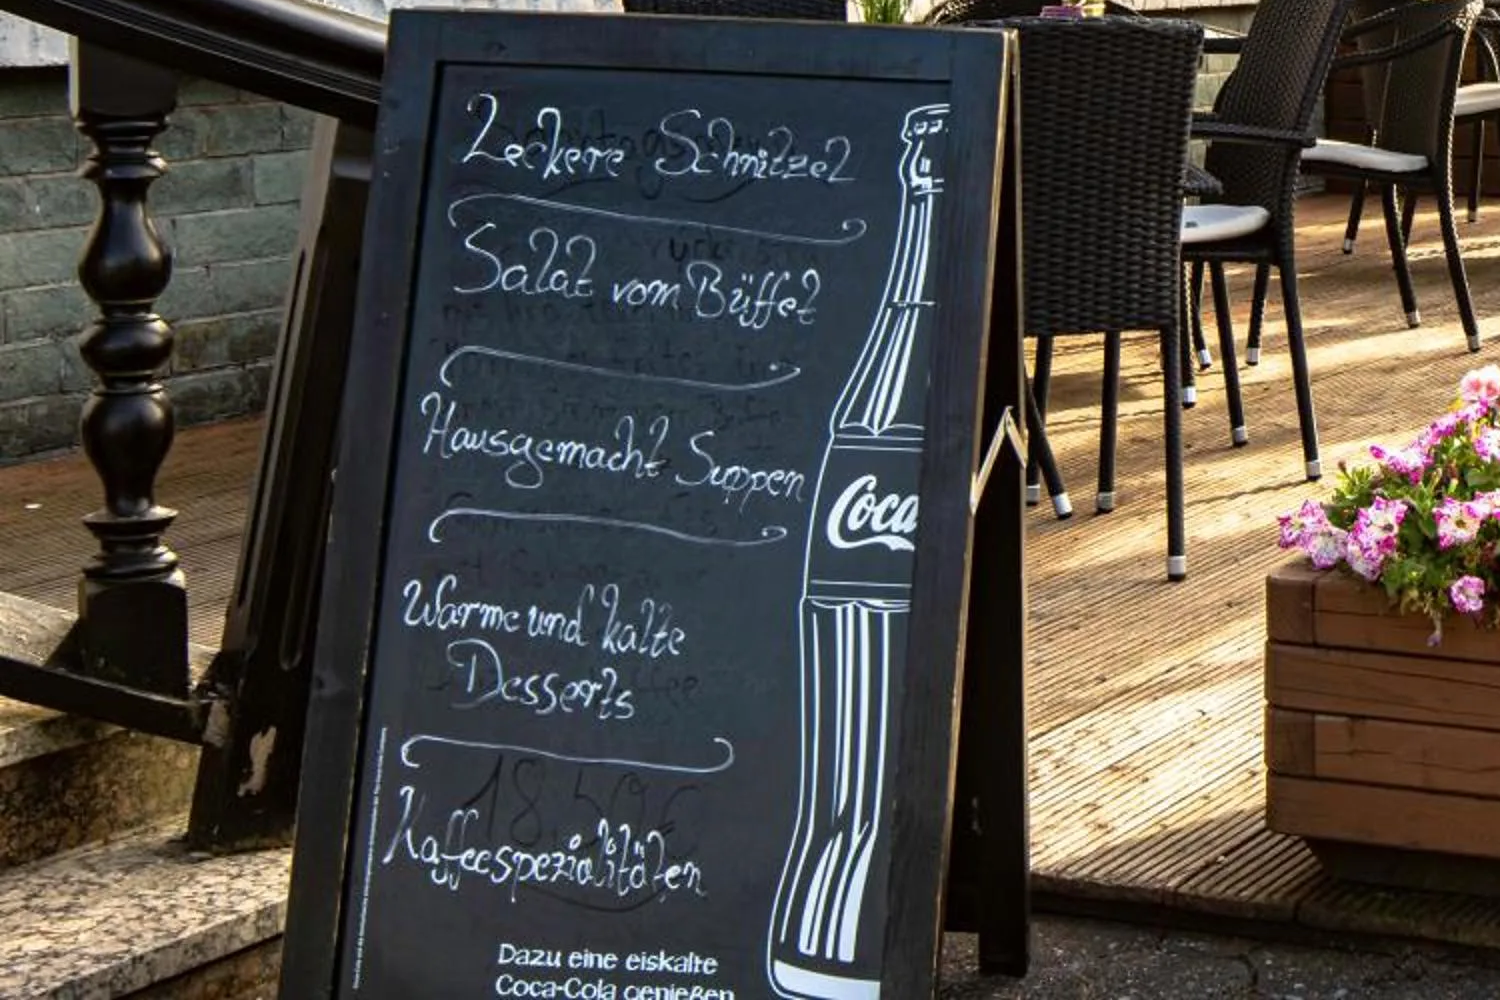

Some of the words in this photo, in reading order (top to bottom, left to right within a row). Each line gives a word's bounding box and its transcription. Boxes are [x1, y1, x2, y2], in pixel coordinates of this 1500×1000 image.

[462, 93, 627, 180] Leckere
[655, 109, 857, 183] Schnitzel
[453, 222, 595, 298] Salat
[612, 279, 682, 308] vom
[675, 431, 806, 512] Suppen
[403, 574, 521, 633] Warme
[527, 583, 595, 647] und
[446, 638, 636, 720] Desserts
[495, 974, 617, 1000] Coca-Cola
[498, 943, 562, 968] Dazu
[568, 948, 618, 969] eine
[625, 950, 719, 974] eiskalte
